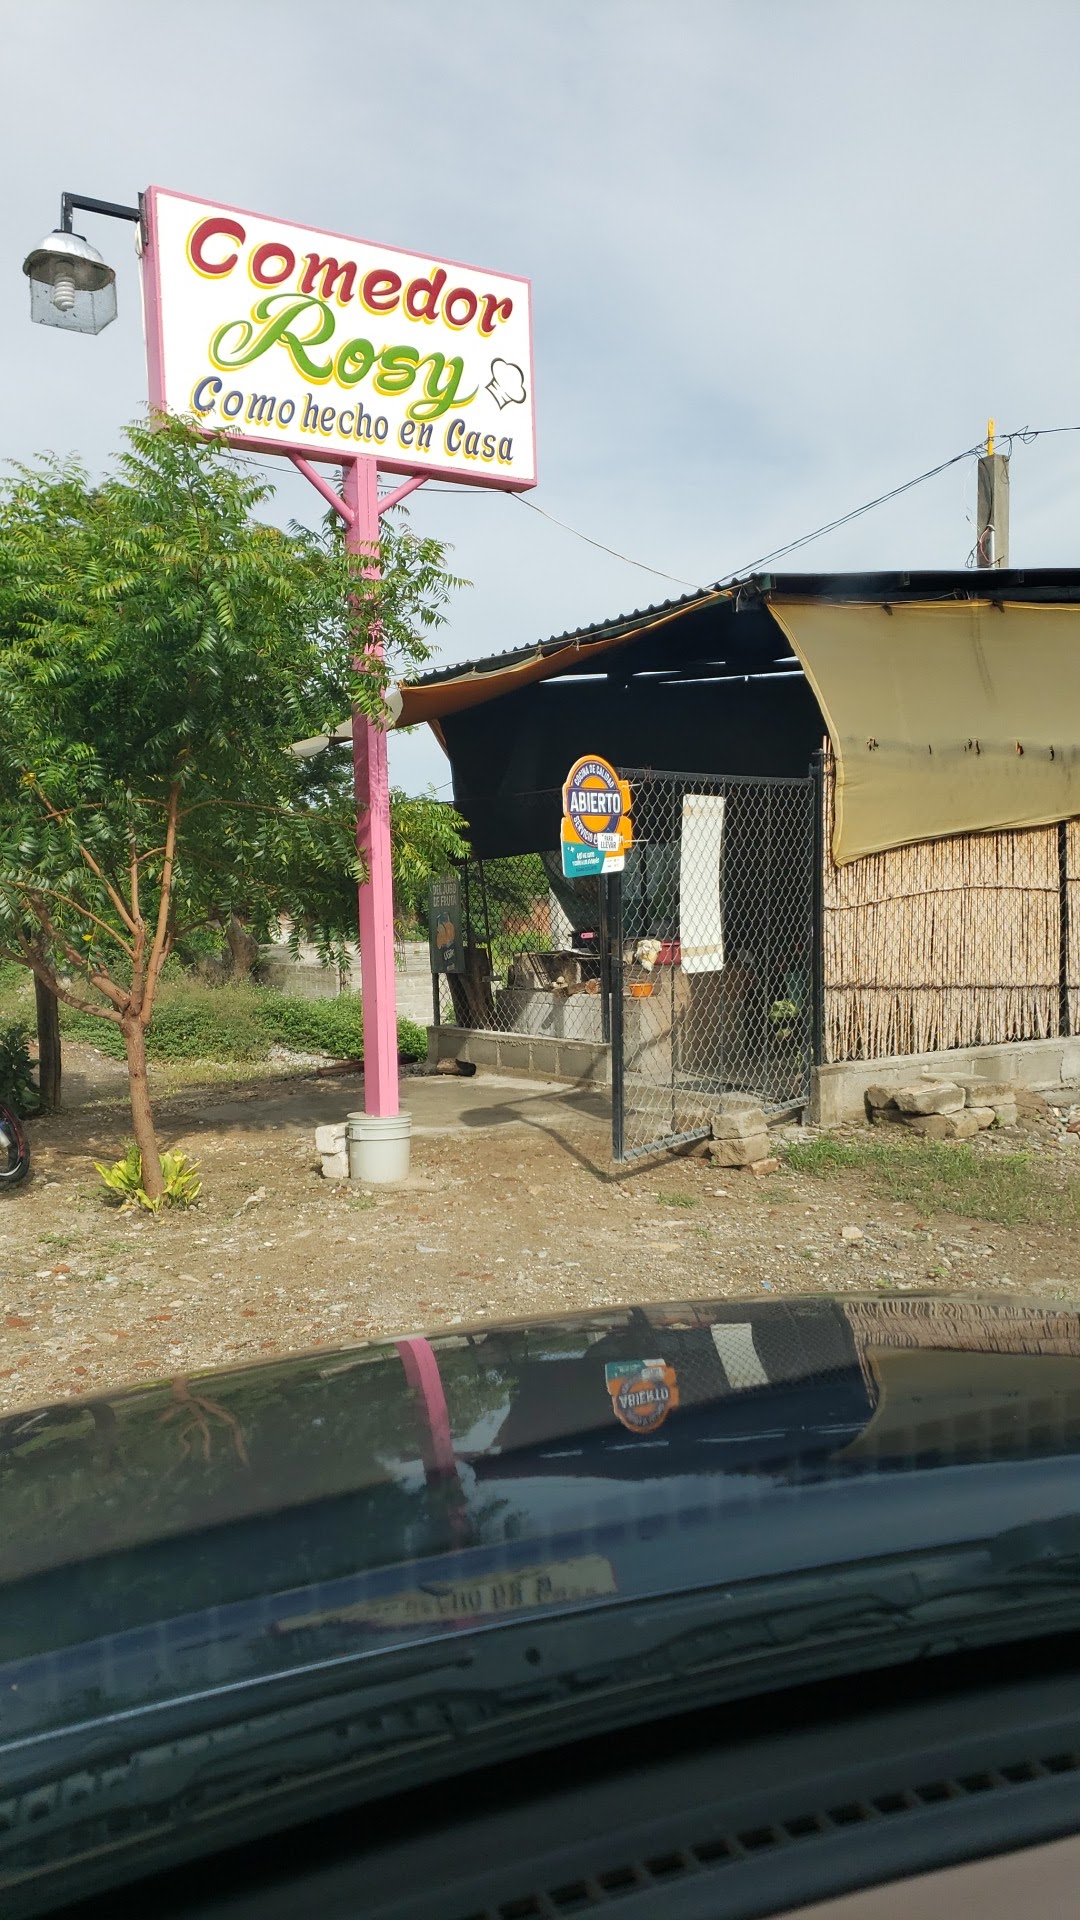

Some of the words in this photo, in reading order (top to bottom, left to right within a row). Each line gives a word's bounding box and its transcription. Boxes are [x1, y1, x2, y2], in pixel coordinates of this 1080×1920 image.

[187, 216, 513, 335] Comedor
[210, 293, 479, 421] Rosy
[191, 376, 295, 429] Como
[302, 393, 390, 445] hecho
[400, 420, 434, 452] en
[446, 418, 514, 465] Casa
[574, 765, 589, 786] COCINA
[588, 764, 596, 774] DE
[596, 765, 615, 788] CALIDAD
[570, 791, 621, 814] ABIERTO
[573, 815, 594, 843] SERVICIO
[600, 841, 617, 849] LLEVAR
